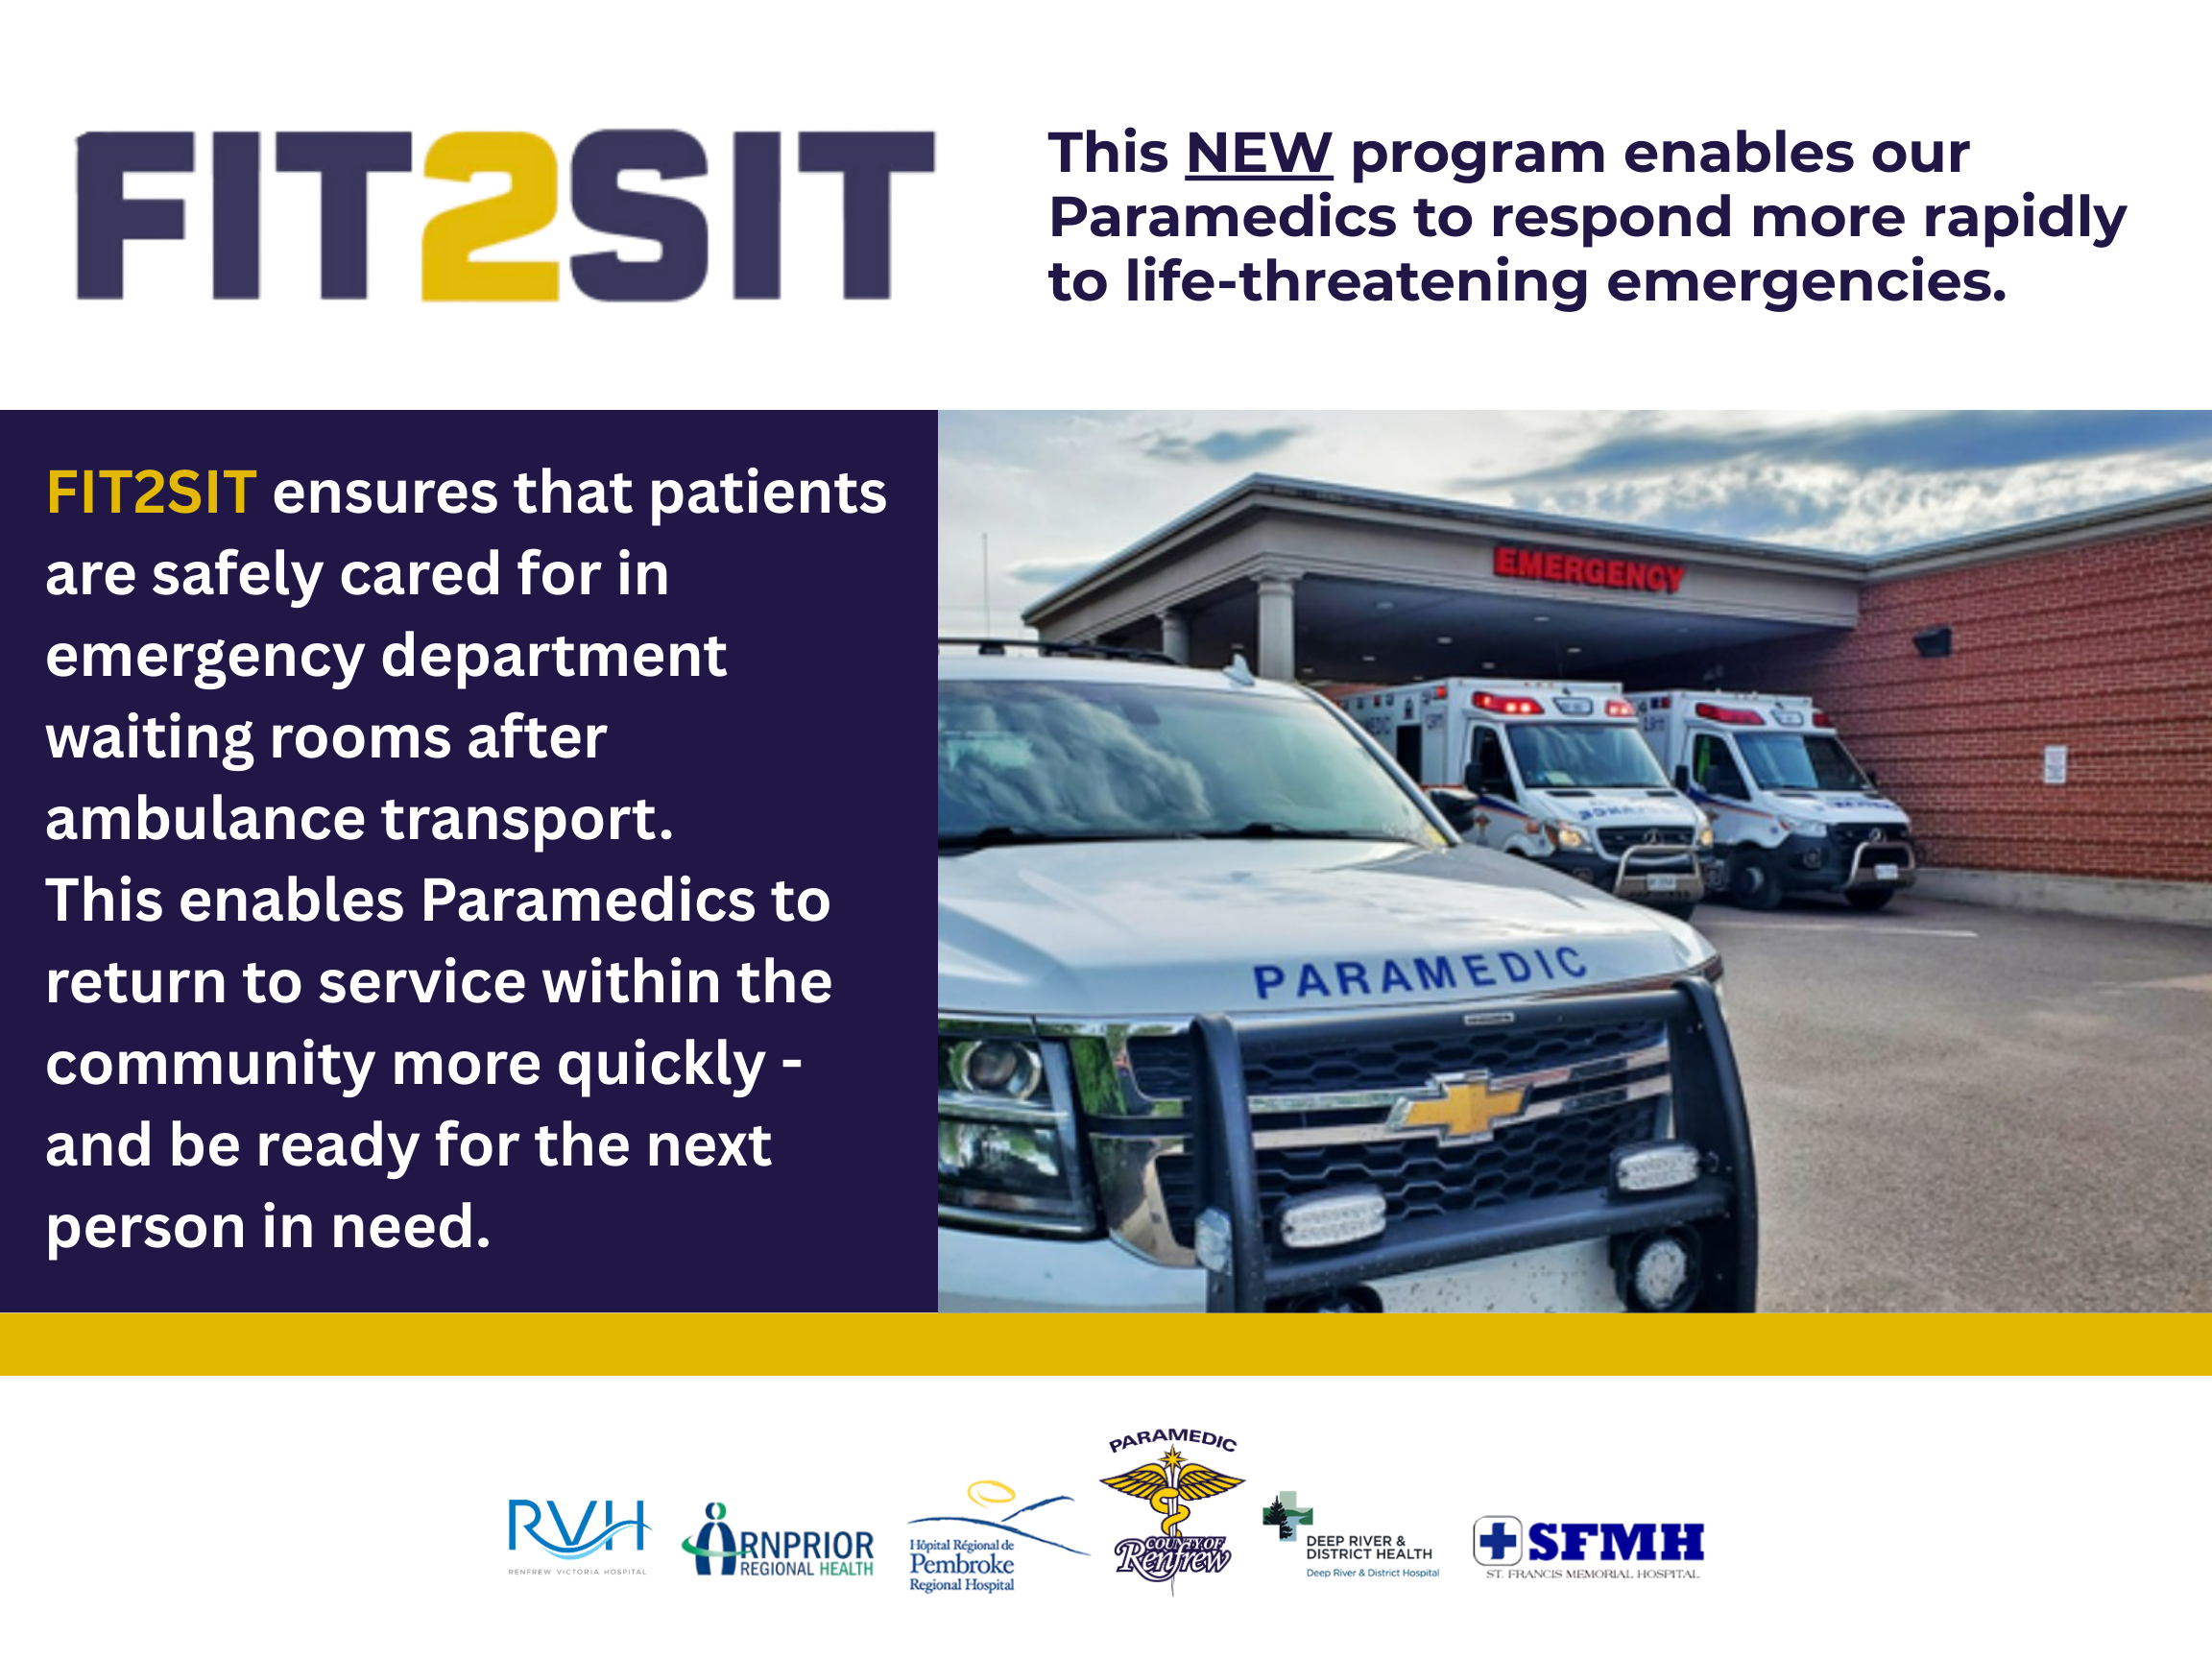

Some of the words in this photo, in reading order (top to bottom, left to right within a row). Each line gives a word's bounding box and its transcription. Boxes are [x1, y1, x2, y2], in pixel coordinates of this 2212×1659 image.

[1047, 127, 1167, 173] This
[1185, 132, 1334, 180] NEW
[1354, 141, 1604, 183] program
[1625, 130, 1854, 173] enables
[1872, 141, 1970, 173] our
[75, 129, 935, 302] FIT2SIT
[1052, 191, 1396, 237] Paramedics
[1413, 199, 1472, 237] to
[1494, 194, 1730, 248] respond
[1754, 205, 1905, 237] more
[1926, 191, 2128, 248] rapidly
[1048, 263, 1107, 301] to
[1128, 255, 1586, 312] life-threatening
[1608, 255, 2006, 312] emergencies.
[50, 469, 256, 514] FIT2SIT
[275, 480, 497, 514] ensures
[514, 468, 633, 514] that
[652, 468, 886, 526] patients
[47, 562, 135, 595] are
[153, 548, 324, 608] safely
[342, 549, 498, 595] cared
[517, 548, 602, 595] for
[619, 549, 667, 594] in
[1494, 545, 1685, 593] EMERGENCY
[47, 639, 366, 689] emergency
[383, 631, 727, 689] department
[45, 712, 254, 771] waiting
[273, 725, 450, 758] rooms
[469, 711, 608, 758] after
[47, 794, 364, 840] ambulance
[381, 800, 672, 853] transport.
[45, 876, 162, 922] This
[180, 876, 403, 922] enables
[424, 876, 755, 922] Paramedics
[771, 881, 830, 922] to
[49, 963, 225, 1003] return
[243, 963, 301, 1003] to
[319, 957, 525, 1003] service
[542, 957, 718, 1003] within
[737, 957, 831, 1003] the
[1253, 946, 1588, 1000] PARAMEDIC
[47, 1039, 375, 1097] community
[395, 1051, 540, 1085] more
[559, 1039, 766, 1097] quickly
[47, 1120, 150, 1166] and
[173, 1120, 239, 1166] be
[259, 1120, 421, 1179] ready
[436, 1119, 519, 1166] for
[535, 1120, 629, 1166] the
[650, 1126, 772, 1166] next
[49, 1214, 243, 1261] person
[264, 1202, 312, 1247] in
[334, 1202, 489, 1248] need.
[1109, 1429, 1238, 1454] PARAMEDIC
[509, 1500, 652, 1553] RVH
[909, 1539, 950, 1554] Hôpital
[952, 1539, 999, 1554] Régional
[1000, 1539, 1015, 1551] de
[1145, 1536, 1204, 1550] COUNTY
[1203, 1536, 1226, 1550] OF
[1307, 1536, 1345, 1547] DEEP
[1349, 1536, 1392, 1547] RIVER
[1395, 1535, 1407, 1547] &
[1528, 1523, 1705, 1561] SFMH
[740, 1561, 815, 1576] REGIONAL
[820, 1561, 874, 1576] HEALTH
[909, 1552, 1015, 1575] Pembroke
[1114, 1537, 1232, 1582] Renfrew
[1307, 1549, 1373, 1559] DISTRICT
[1377, 1549, 1432, 1559] HEALTH
[1307, 1568, 1331, 1578] Deep
[1334, 1568, 1357, 1577] River
[1358, 1568, 1366, 1577] &
[1368, 1568, 1401, 1577] District
[1403, 1568, 1440, 1578] Hospital
[1486, 1569, 1504, 1579] ST.
[1508, 1569, 1563, 1579] FRANCIS
[1566, 1569, 1634, 1579] MEMORIAL
[1637, 1569, 1700, 1579] HOSPITAL
[909, 1578, 962, 1595] Regional
[965, 1578, 1015, 1595] Hospital
